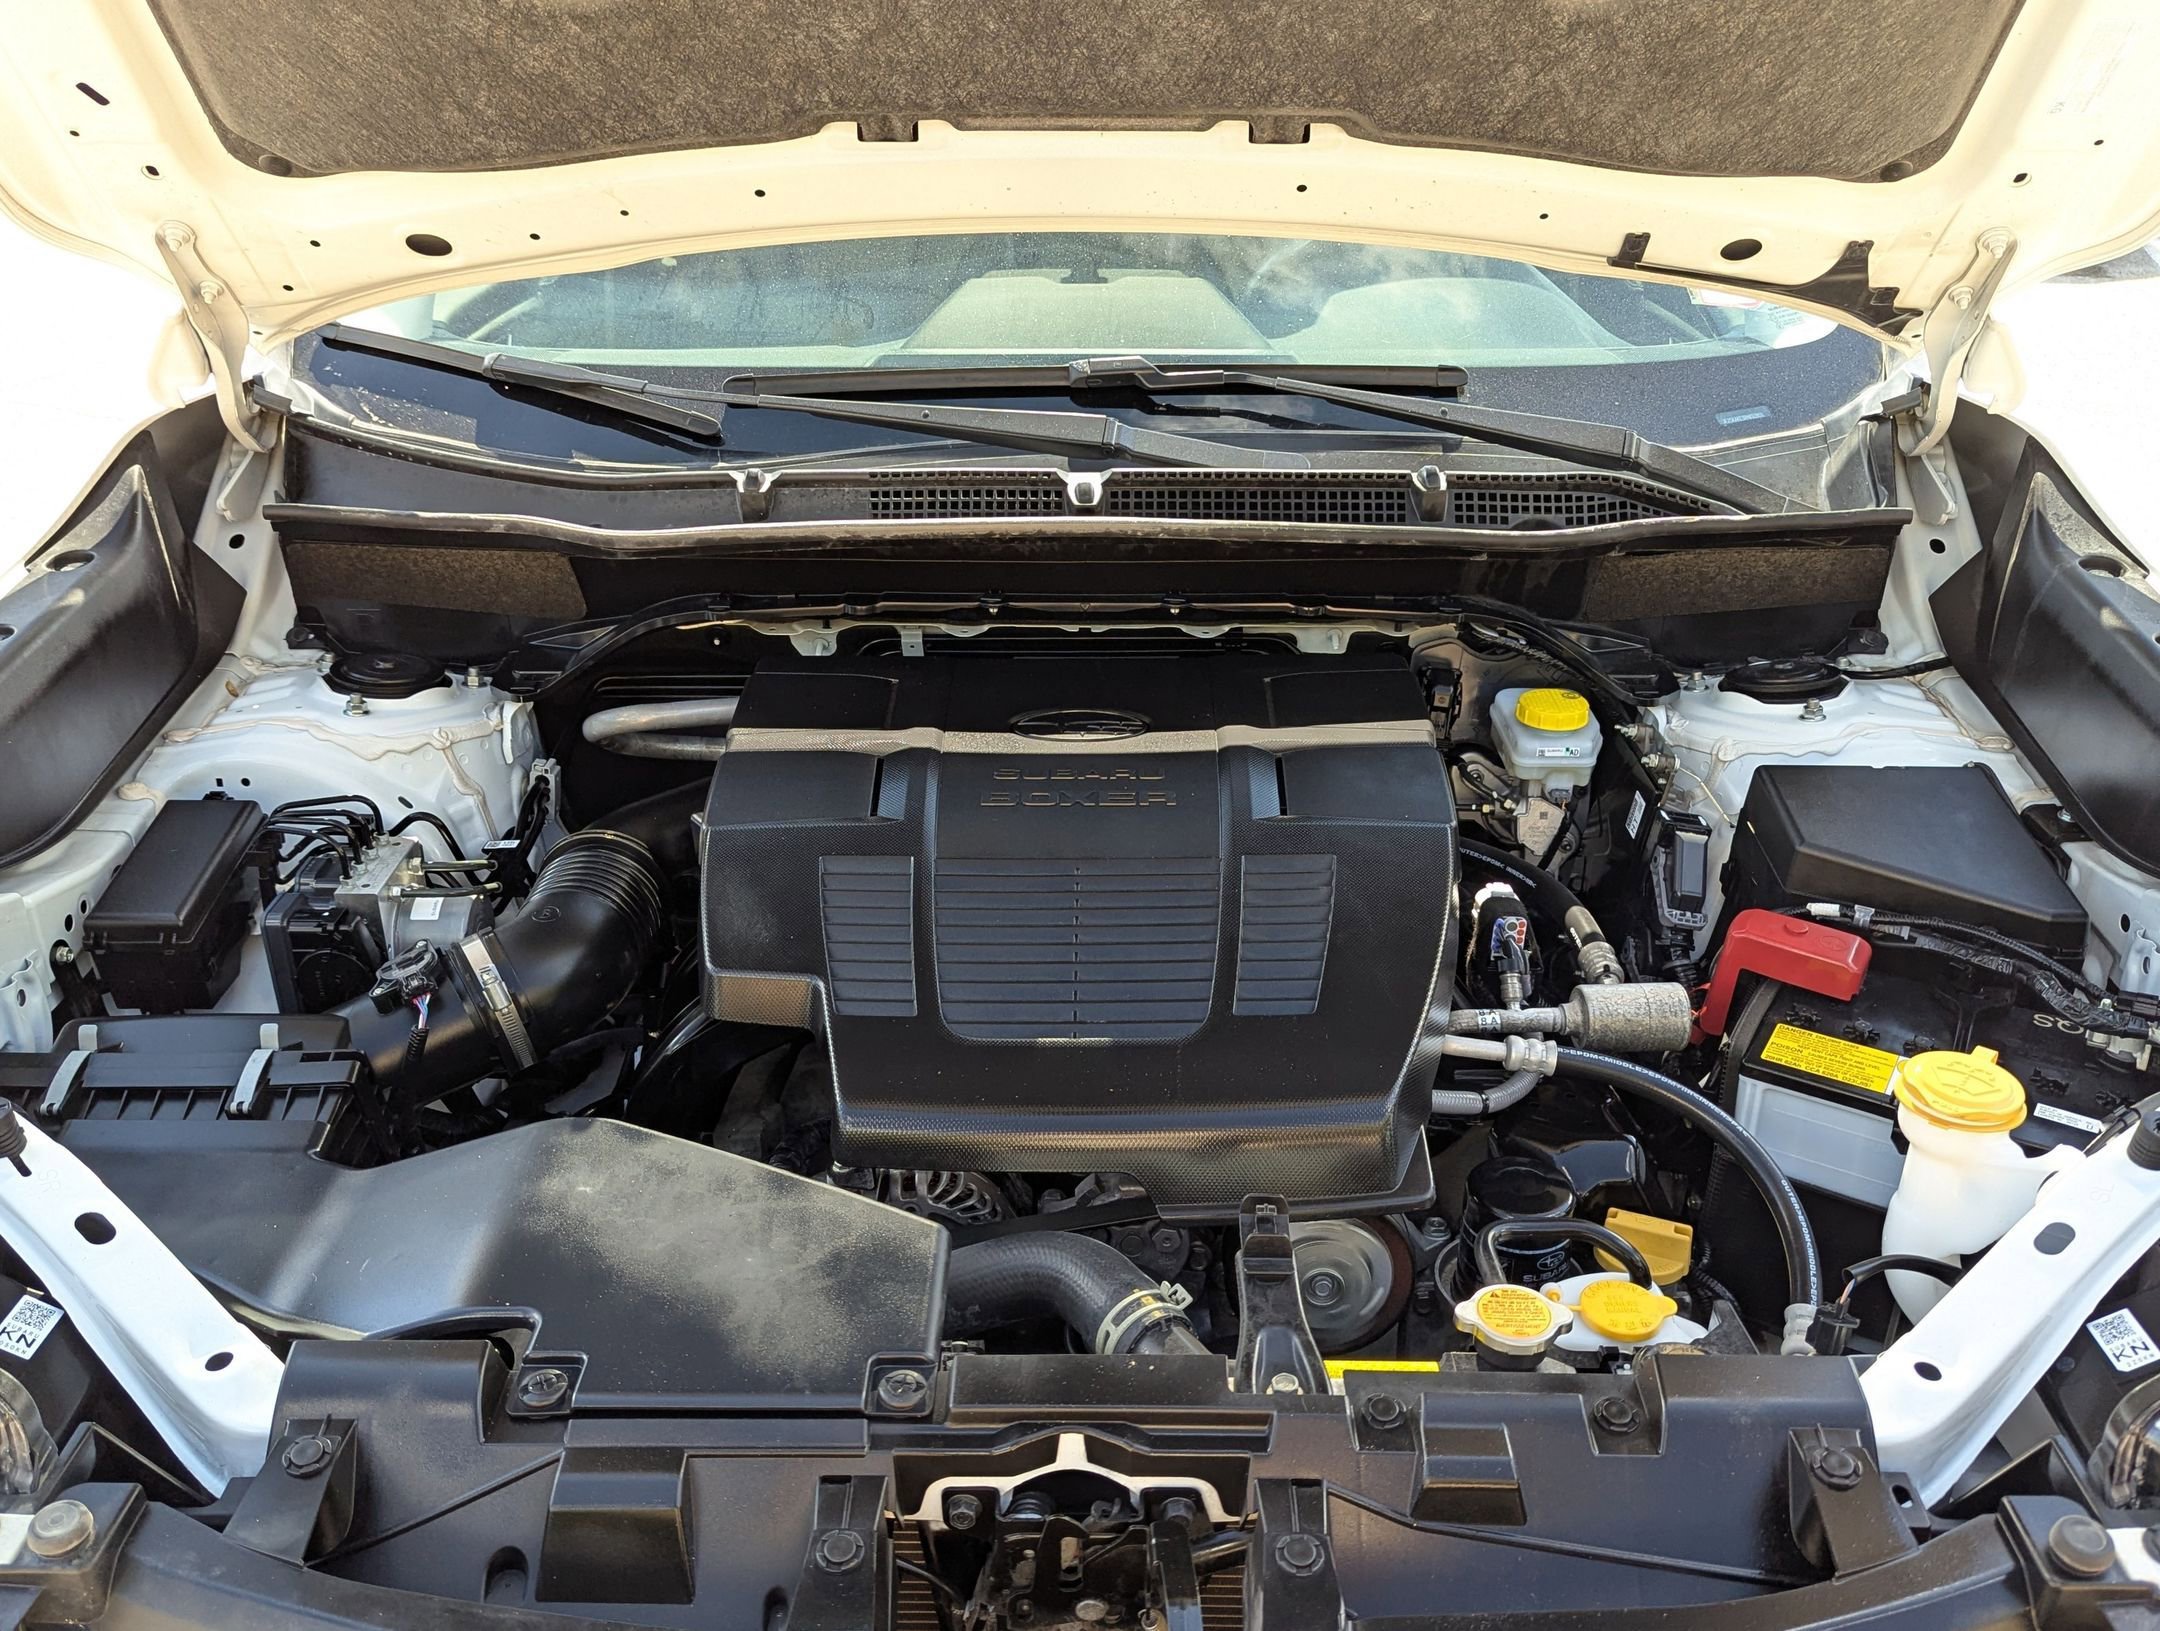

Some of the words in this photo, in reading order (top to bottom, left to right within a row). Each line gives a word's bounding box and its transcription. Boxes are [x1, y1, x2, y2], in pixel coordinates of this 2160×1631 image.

[993, 768, 1166, 780] SUBARU
[980, 790, 1177, 807] BOXER
[1778, 1024, 1814, 1038] DANGER
[1769, 1040, 1804, 1054] POISON
[0, 1326, 36, 1348] KN
[7, 1322, 40, 1339] SUBARU
[2112, 1341, 2150, 1362] KN
